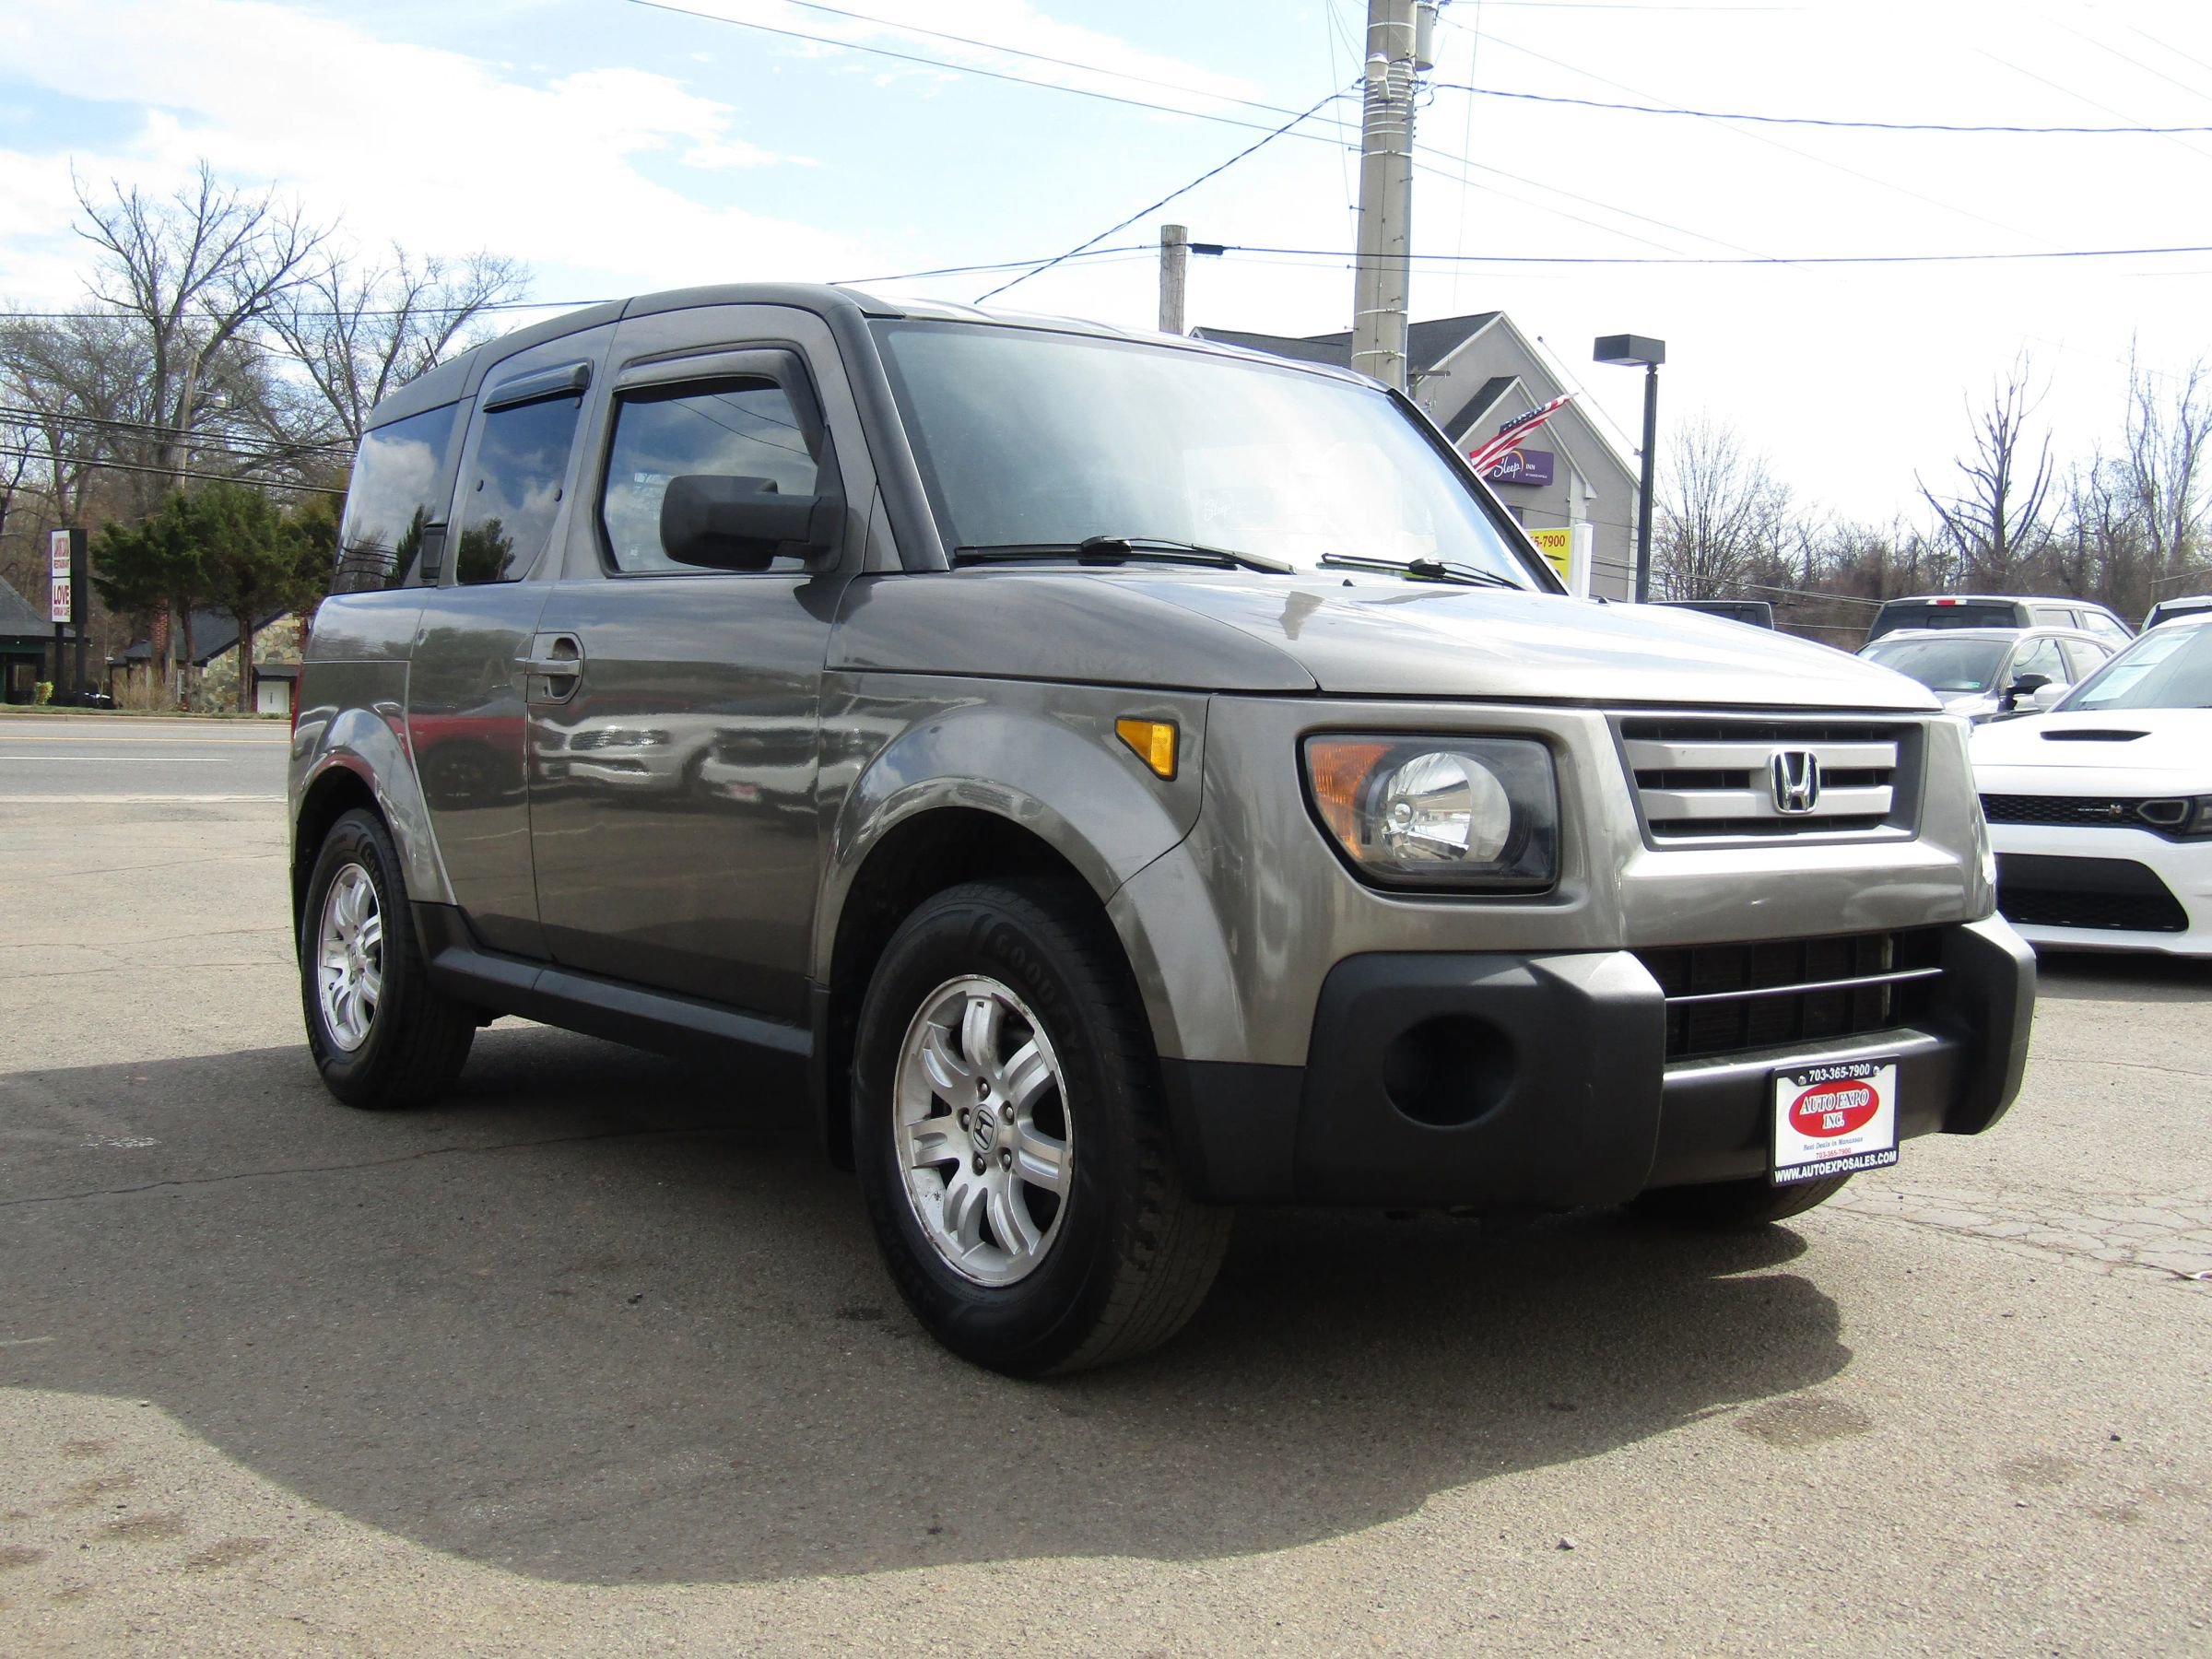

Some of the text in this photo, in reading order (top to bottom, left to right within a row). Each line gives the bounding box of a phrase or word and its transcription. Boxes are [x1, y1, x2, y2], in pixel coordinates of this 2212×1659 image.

[1493, 456, 1520, 477] Sleep
[53, 584, 70, 605] LOVE
[1809, 1064, 1870, 1082] 703-365-7900
[1800, 1088, 1870, 1115] AUTO EXPO
[1823, 1112, 1845, 1129] INC.
[1774, 1150, 1897, 1182] WWW.AUTOEXPOSALES.COM
